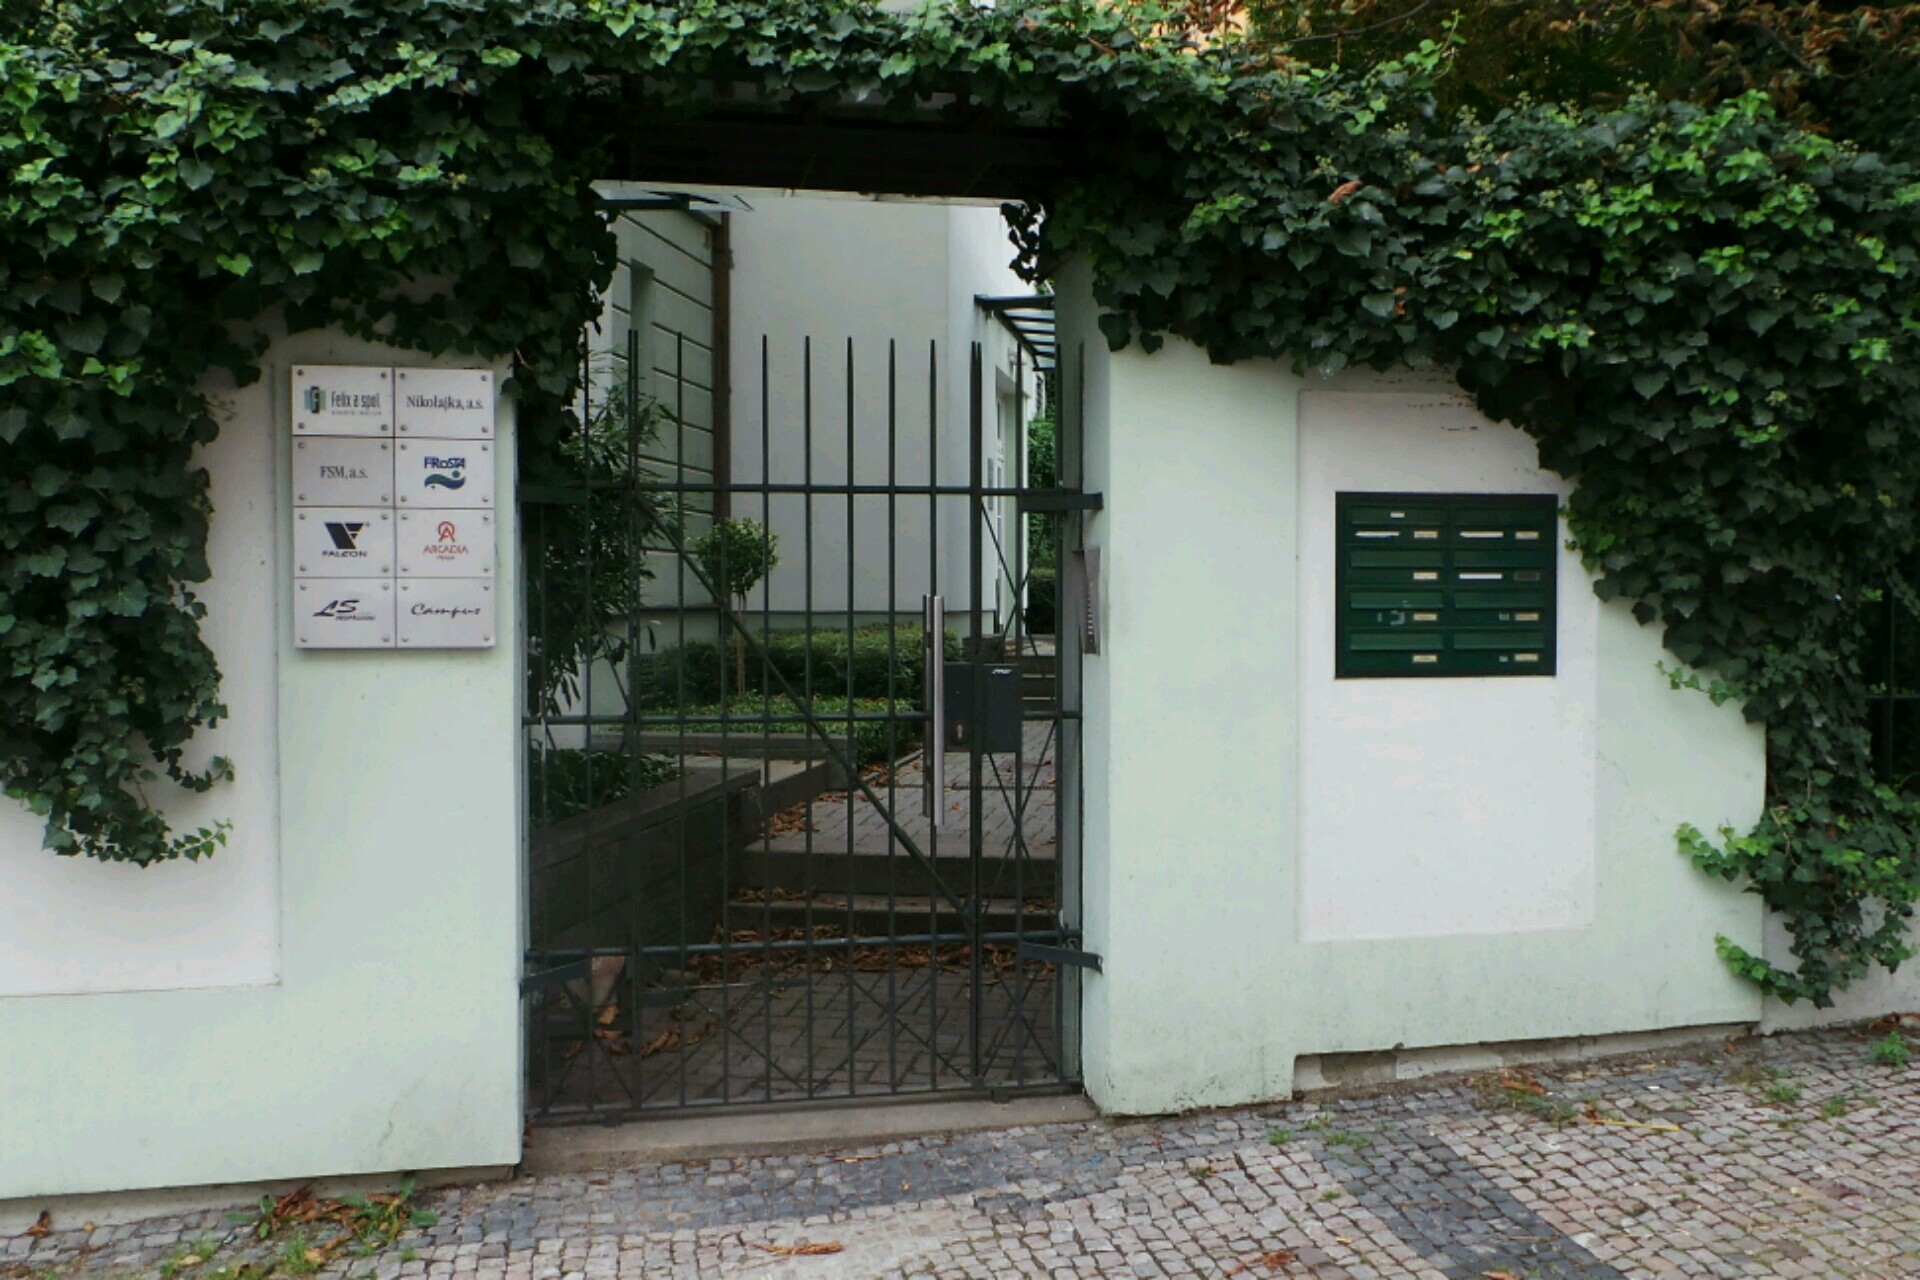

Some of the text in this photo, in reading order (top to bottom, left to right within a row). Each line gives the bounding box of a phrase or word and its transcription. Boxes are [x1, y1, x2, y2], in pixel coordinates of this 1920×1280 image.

[331, 391, 351, 407] Felix
[353, 393, 359, 407] a
[406, 395, 484, 412] Nikolajka, a.s.
[320, 465, 368, 479] FSM, a.s.
[423, 545, 468, 554] ARCADIA
